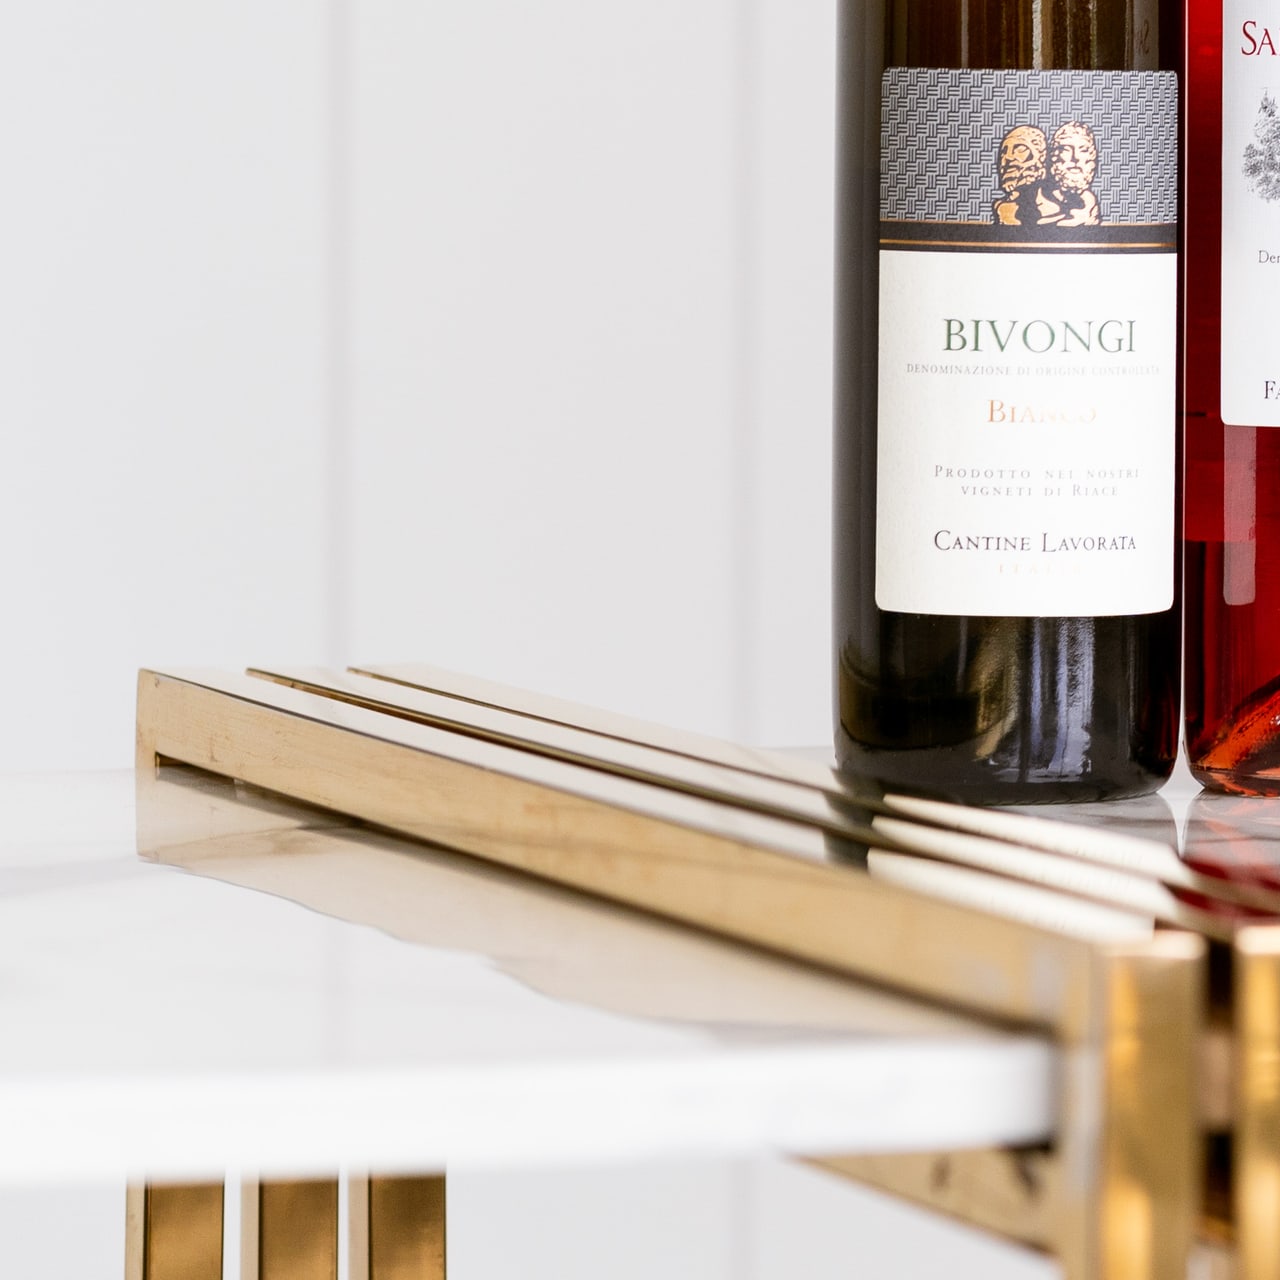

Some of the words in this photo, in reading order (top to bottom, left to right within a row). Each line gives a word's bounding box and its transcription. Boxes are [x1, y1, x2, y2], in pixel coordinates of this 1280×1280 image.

[942, 318, 1136, 353] BIVONGI
[907, 363, 1010, 376] DENOMINAZIONE
[1017, 366, 1030, 376] DI
[1035, 366, 1087, 376] ORIGINE
[934, 464, 1031, 479] PRODOTTO
[1045, 470, 1073, 479] NEI
[1087, 469, 1139, 479] NOSTRI
[961, 485, 1032, 496] VIGNETI
[1044, 487, 1061, 497] DI
[1072, 484, 1119, 497] RIACE
[933, 529, 1031, 552] CANTINE
[1041, 532, 1137, 552] LAVORATA
